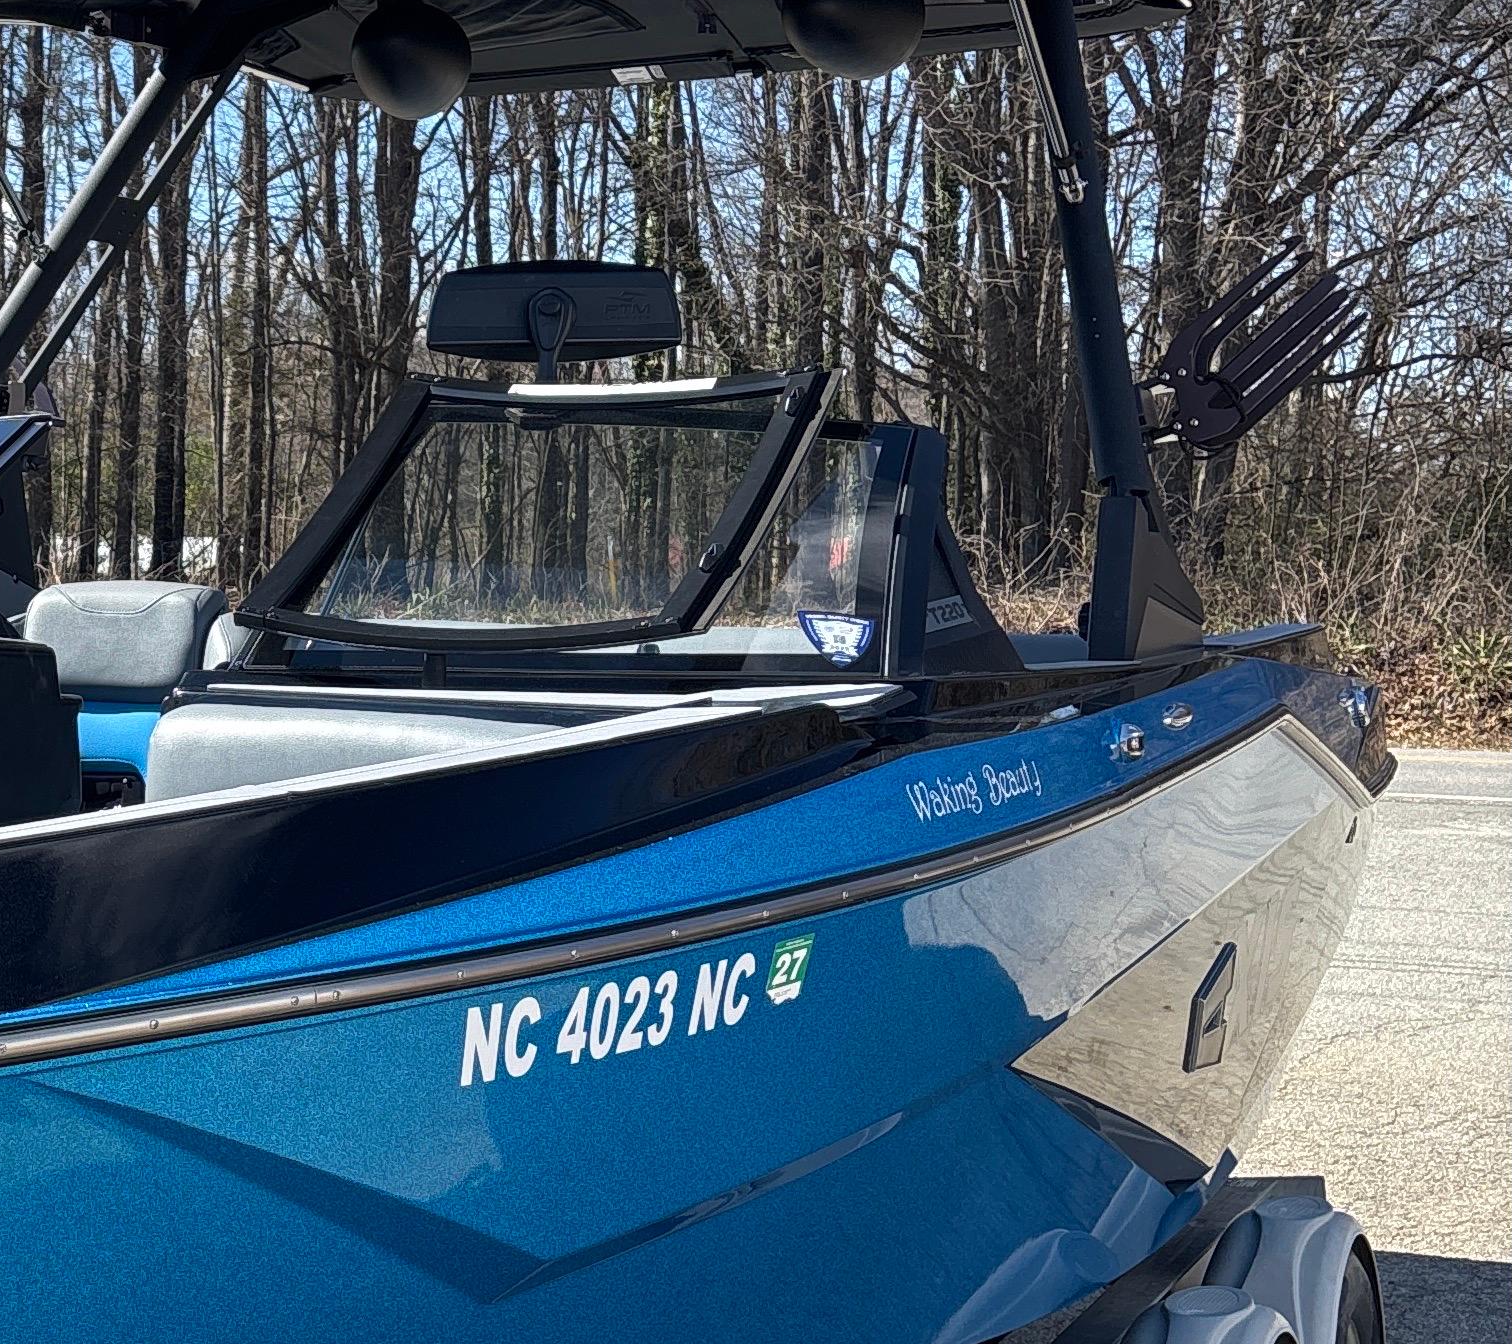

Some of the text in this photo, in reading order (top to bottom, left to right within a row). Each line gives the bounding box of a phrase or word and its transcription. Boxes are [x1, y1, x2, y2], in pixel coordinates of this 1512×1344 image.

[905, 758, 1042, 824] Waking Beauty
[772, 947, 808, 985] 27
[460, 952, 756, 1087] NC 4023 NC
